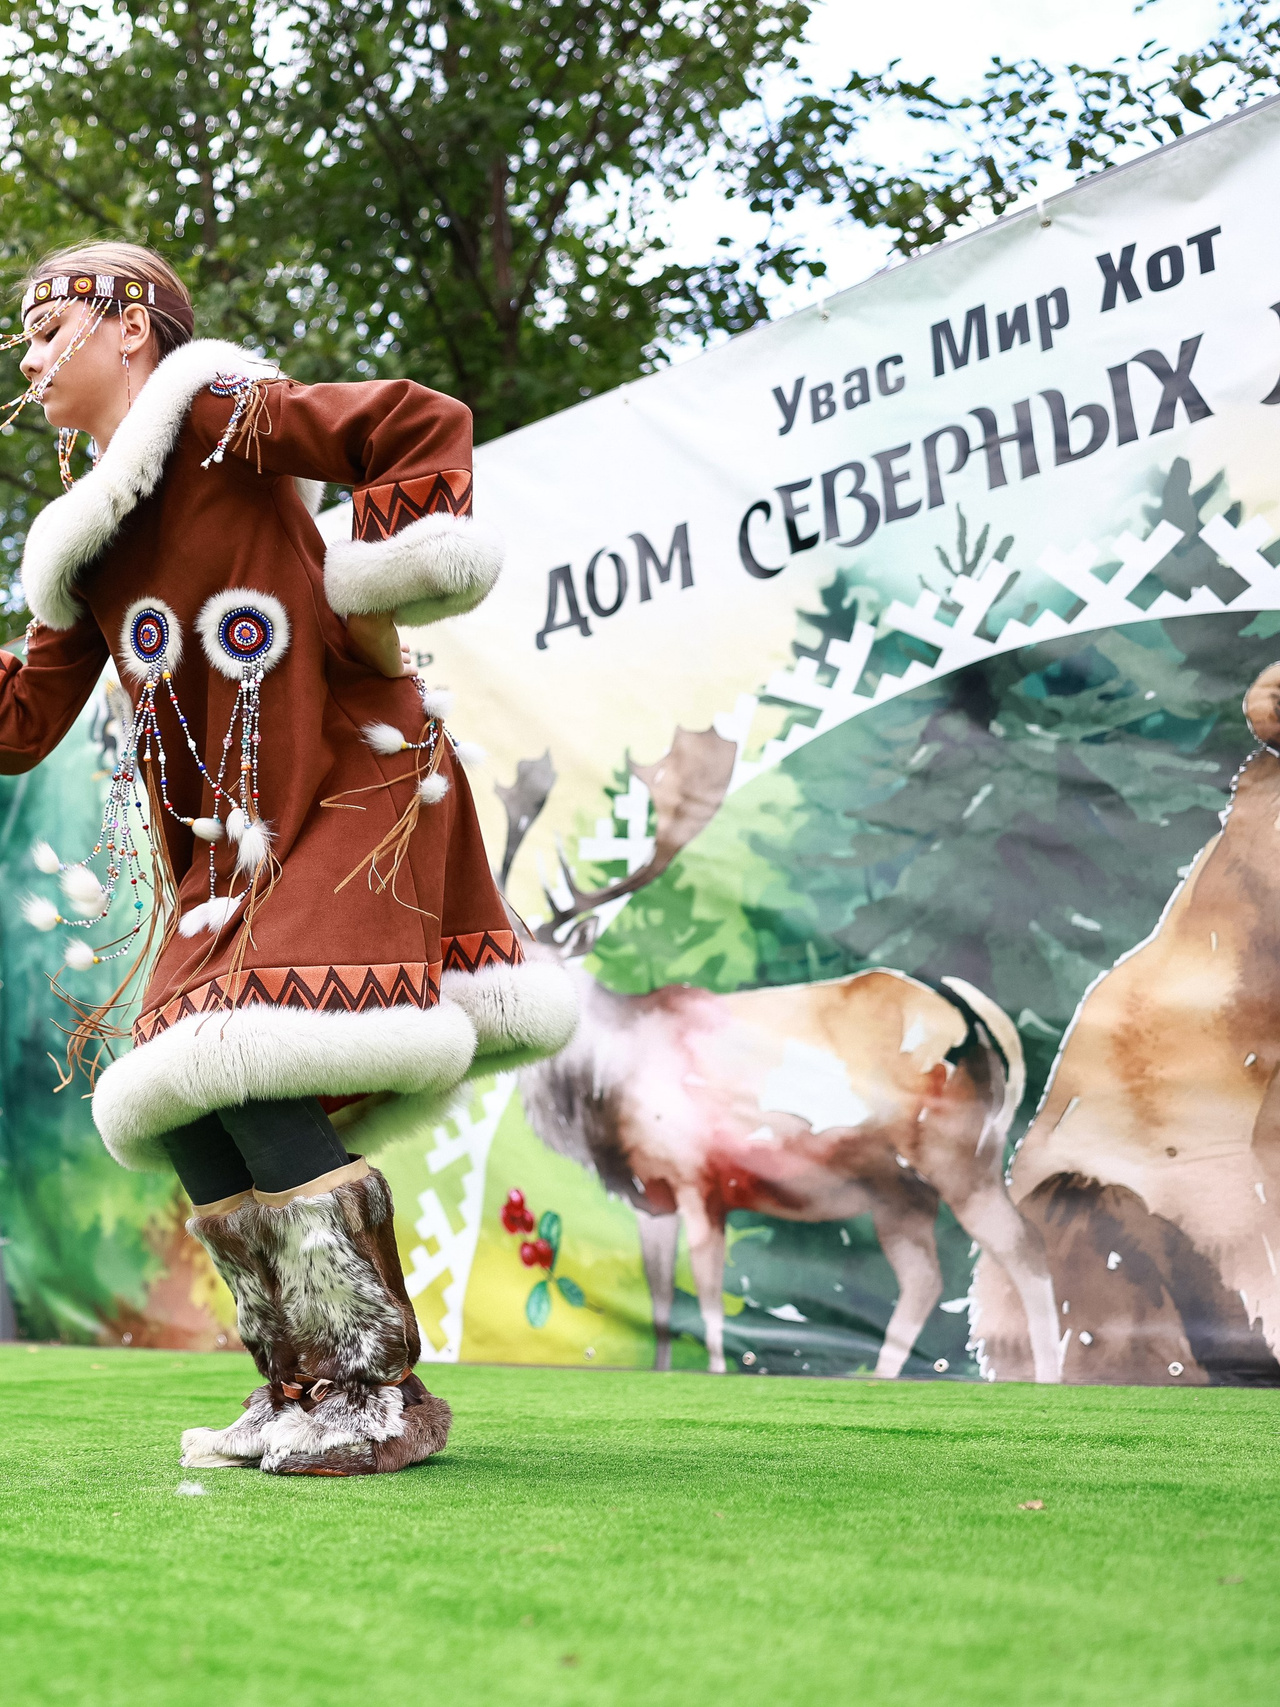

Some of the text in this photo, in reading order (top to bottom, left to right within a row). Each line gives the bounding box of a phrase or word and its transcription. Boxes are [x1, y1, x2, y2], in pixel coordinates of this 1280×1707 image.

[772, 225, 1222, 436] Увас Мир Хот
[535, 522, 695, 650] ДОМ
[737, 332, 1215, 580] СЕВЕРНЫХ
